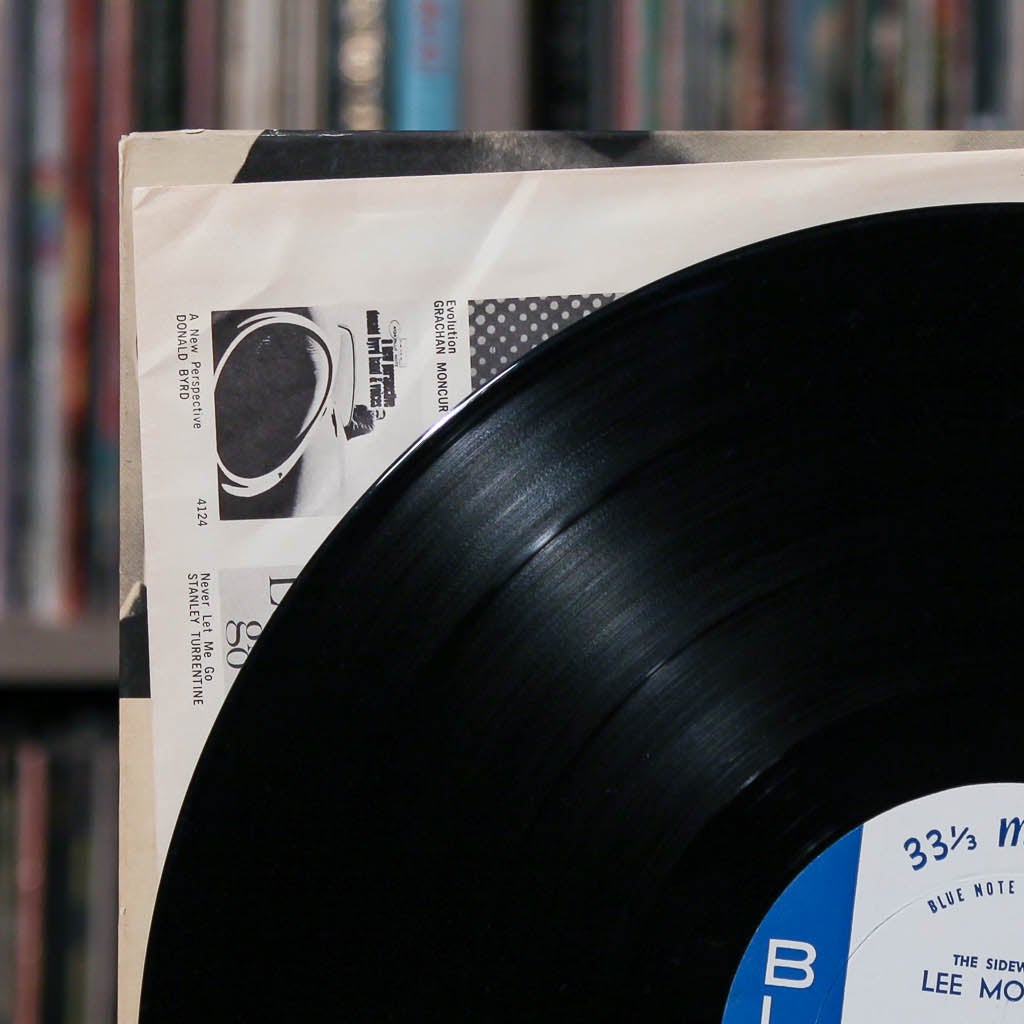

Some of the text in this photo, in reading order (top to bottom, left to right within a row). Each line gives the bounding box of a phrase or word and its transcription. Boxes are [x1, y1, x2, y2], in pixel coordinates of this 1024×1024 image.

[446, 300, 458, 354] Evolution
[176, 314, 190, 400] DONALD BYRD
[189, 313, 203, 429] A New Perspective
[434, 300, 449, 412] GRACHAN MONCUR
[196, 498, 209, 527] 4124
[187, 573, 204, 706] STANLEY TURRENTINE
[201, 572, 215, 682] Never Let Me Go
[226, 620, 263, 669] go
[927, 887, 965, 914] BLUE
[974, 880, 1015, 898] NOTE
[921, 969, 963, 996] LEE
[953, 954, 979, 969] THE
